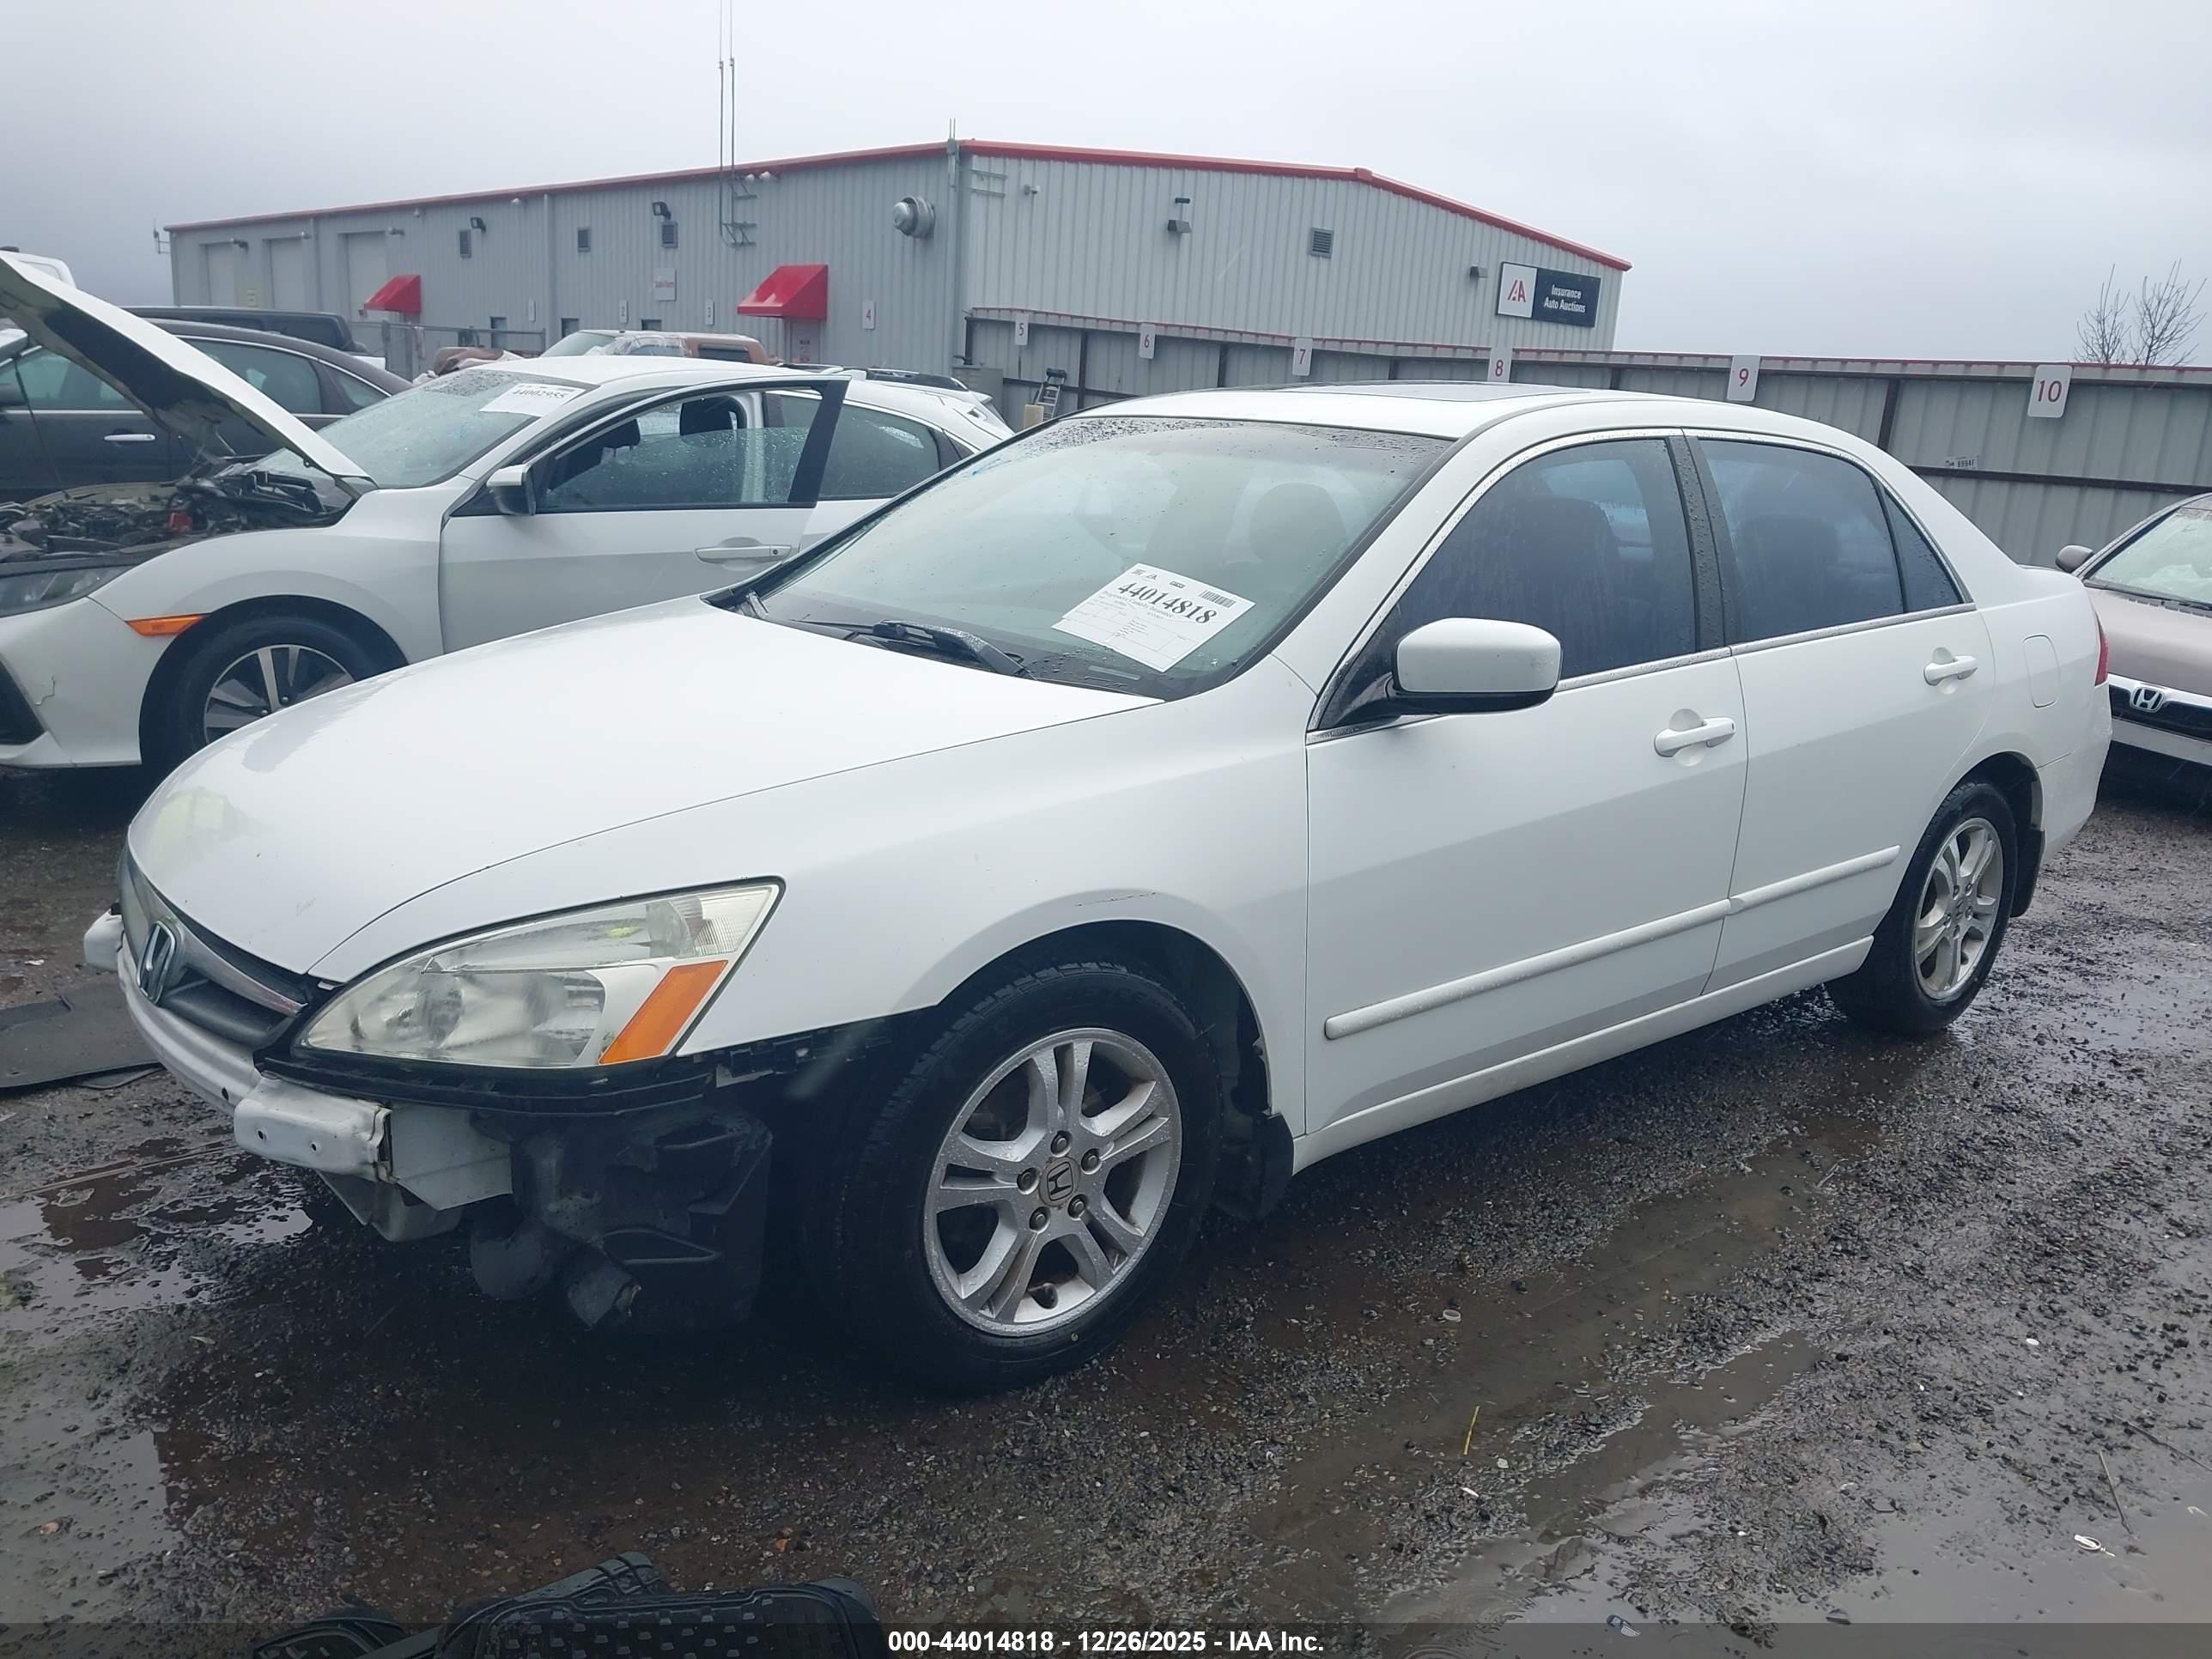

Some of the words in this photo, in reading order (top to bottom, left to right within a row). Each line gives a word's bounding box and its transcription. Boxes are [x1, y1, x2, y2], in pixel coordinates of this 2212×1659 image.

[1551, 284, 1582, 300] Insurance
[1544, 296, 1559, 309] Auto
[1559, 299, 1586, 313] Auctions
[866, 308, 872, 321] 4
[1018, 323, 1024, 337] 5
[1144, 334, 1150, 348] 6
[1298, 349, 1306, 365] 7
[1494, 359, 1504, 377] 8
[1739, 368, 1749, 386] 9
[2038, 380, 2063, 403] 10
[1118, 582, 1217, 624] 44014818
